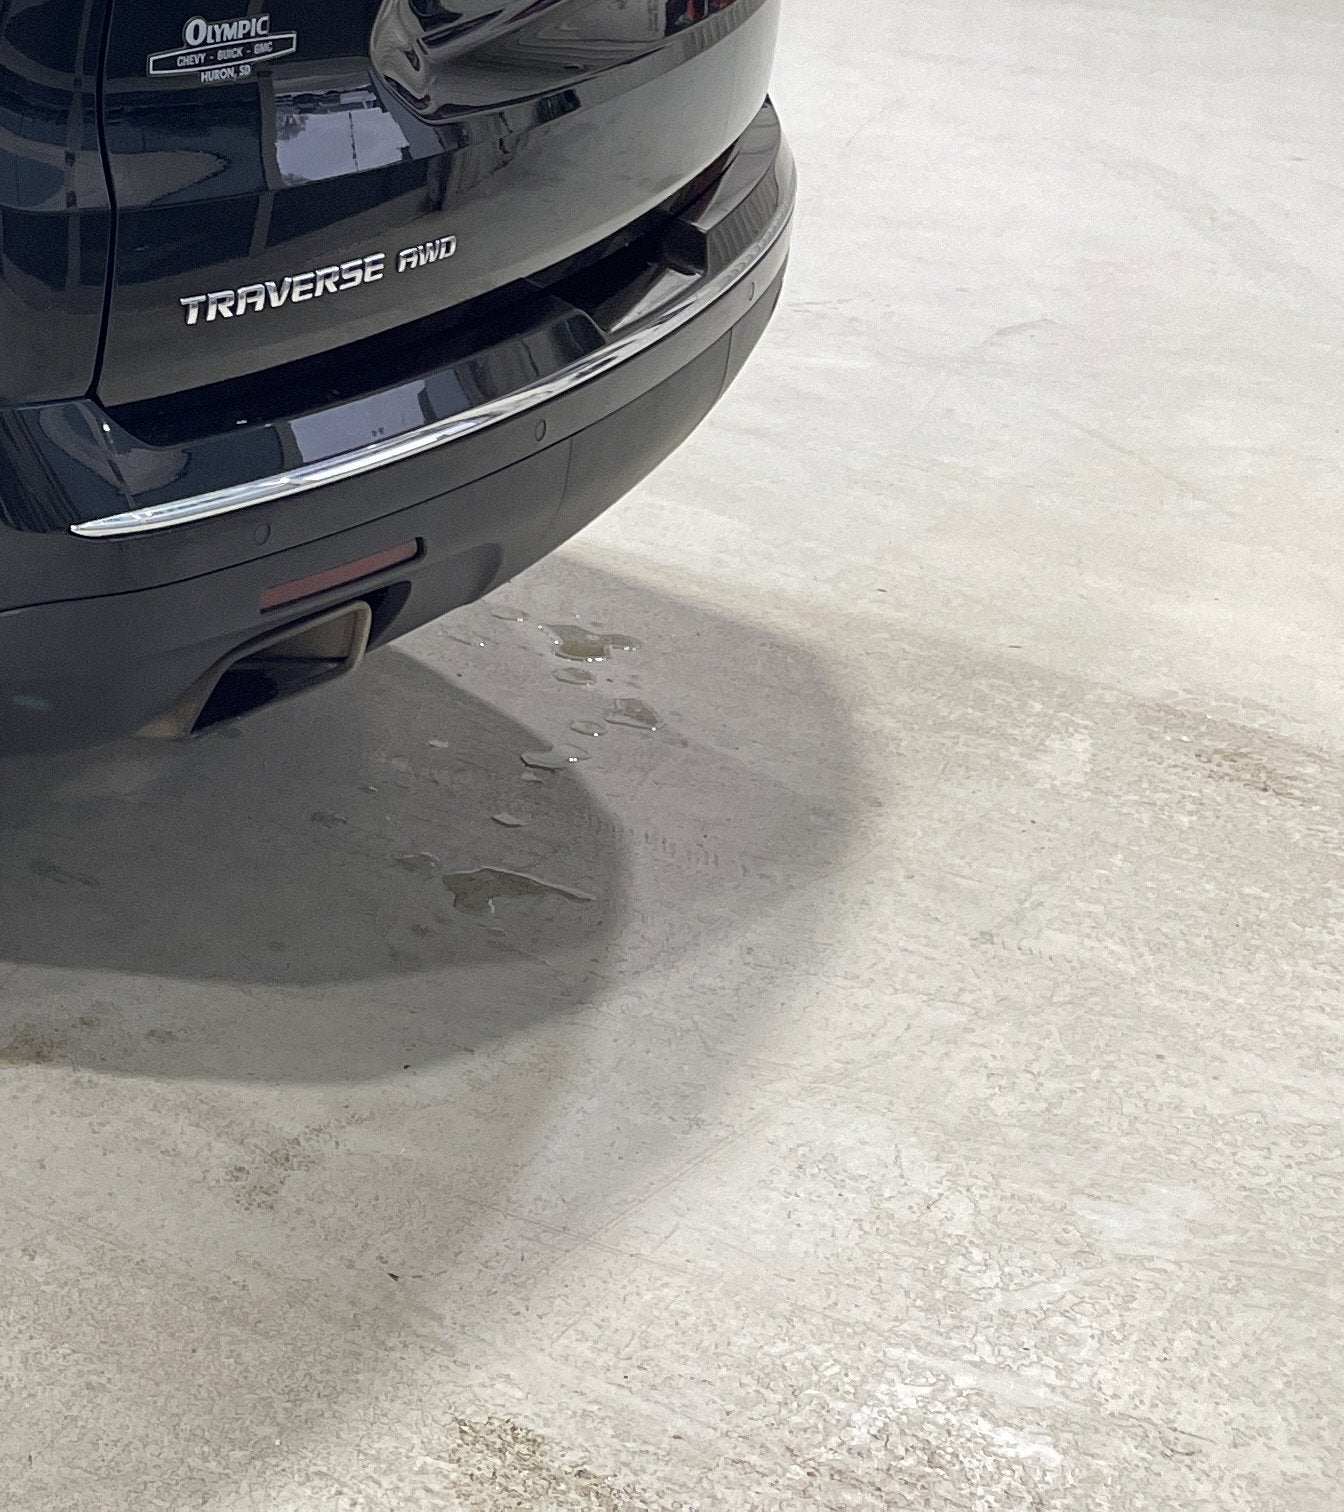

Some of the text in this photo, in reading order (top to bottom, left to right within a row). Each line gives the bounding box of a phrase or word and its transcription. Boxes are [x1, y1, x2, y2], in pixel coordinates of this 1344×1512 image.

[185, 15, 269, 46] OLYMPIC
[177, 53, 206, 67] CHEVY
[217, 46, 243, 61] BUICK
[253, 41, 273, 55] GMC
[200, 64, 251, 83] HURON, SD
[179, 235, 456, 326] TRAVERSE AWD
